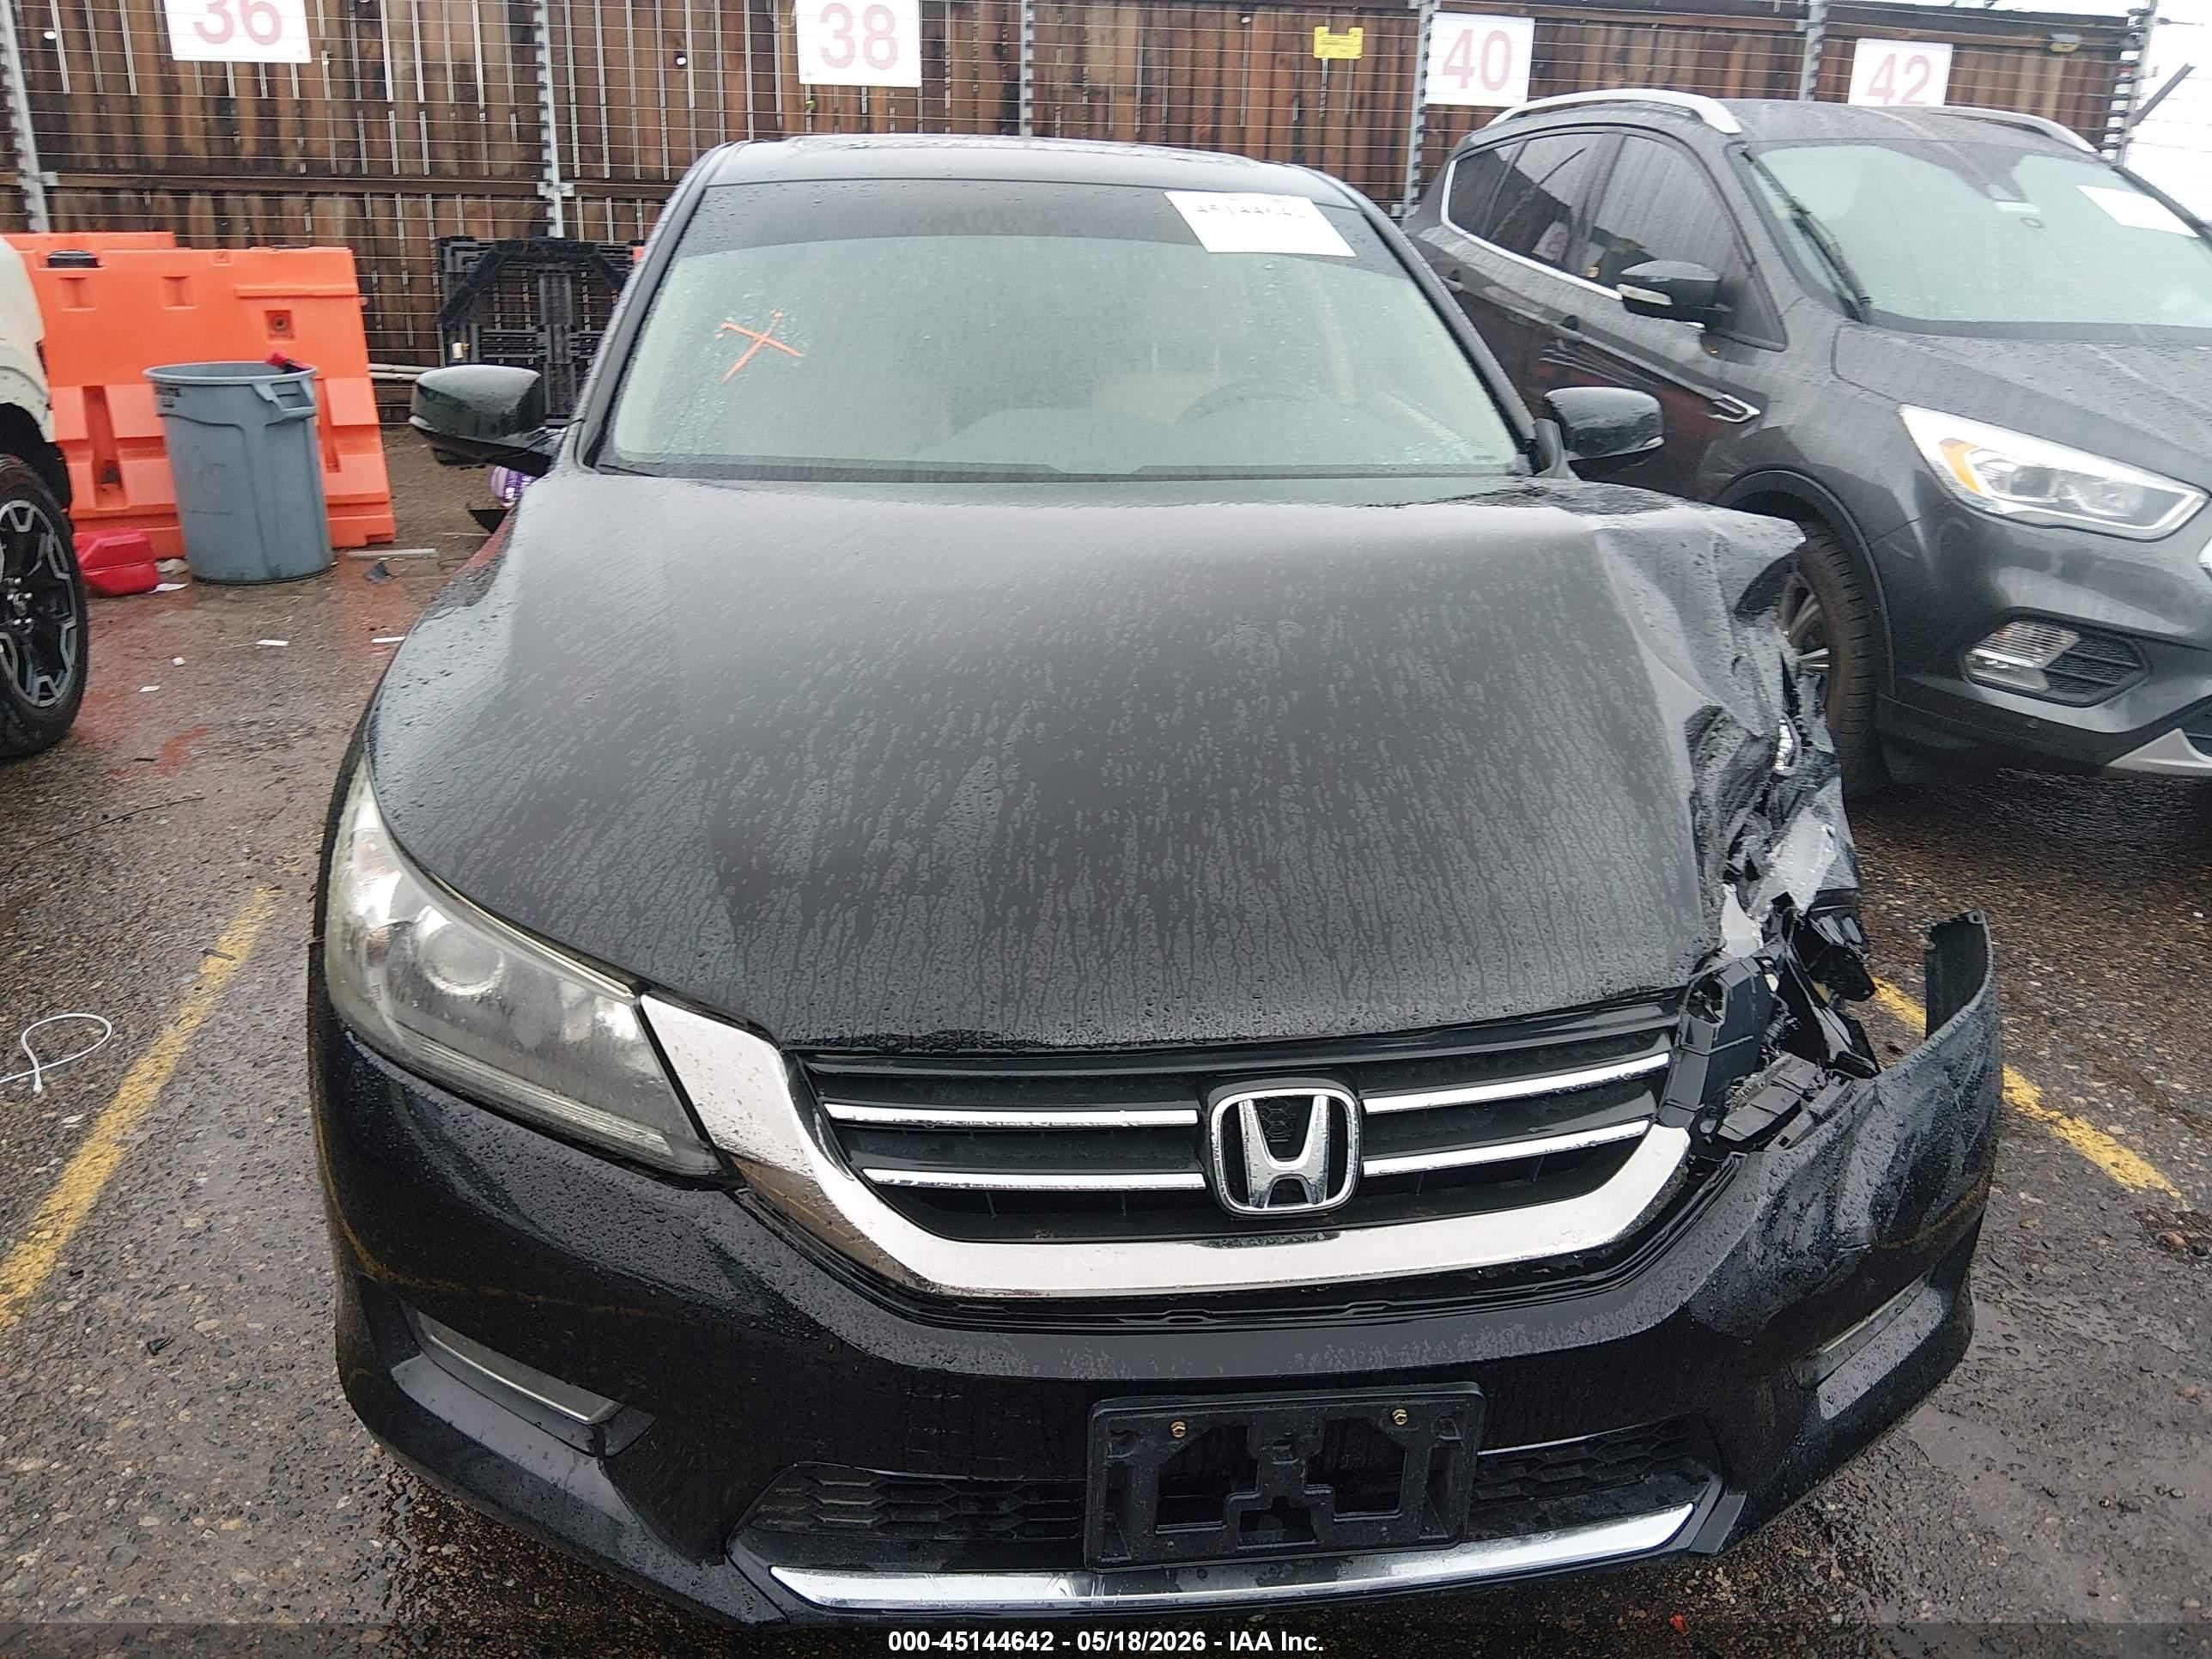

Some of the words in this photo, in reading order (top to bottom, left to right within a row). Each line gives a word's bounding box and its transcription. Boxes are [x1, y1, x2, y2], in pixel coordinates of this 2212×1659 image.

[193, 0, 282, 46] 36
[819, 3, 898, 70] 38
[1442, 28, 1512, 91] 40
[1867, 53, 1931, 106] 42
